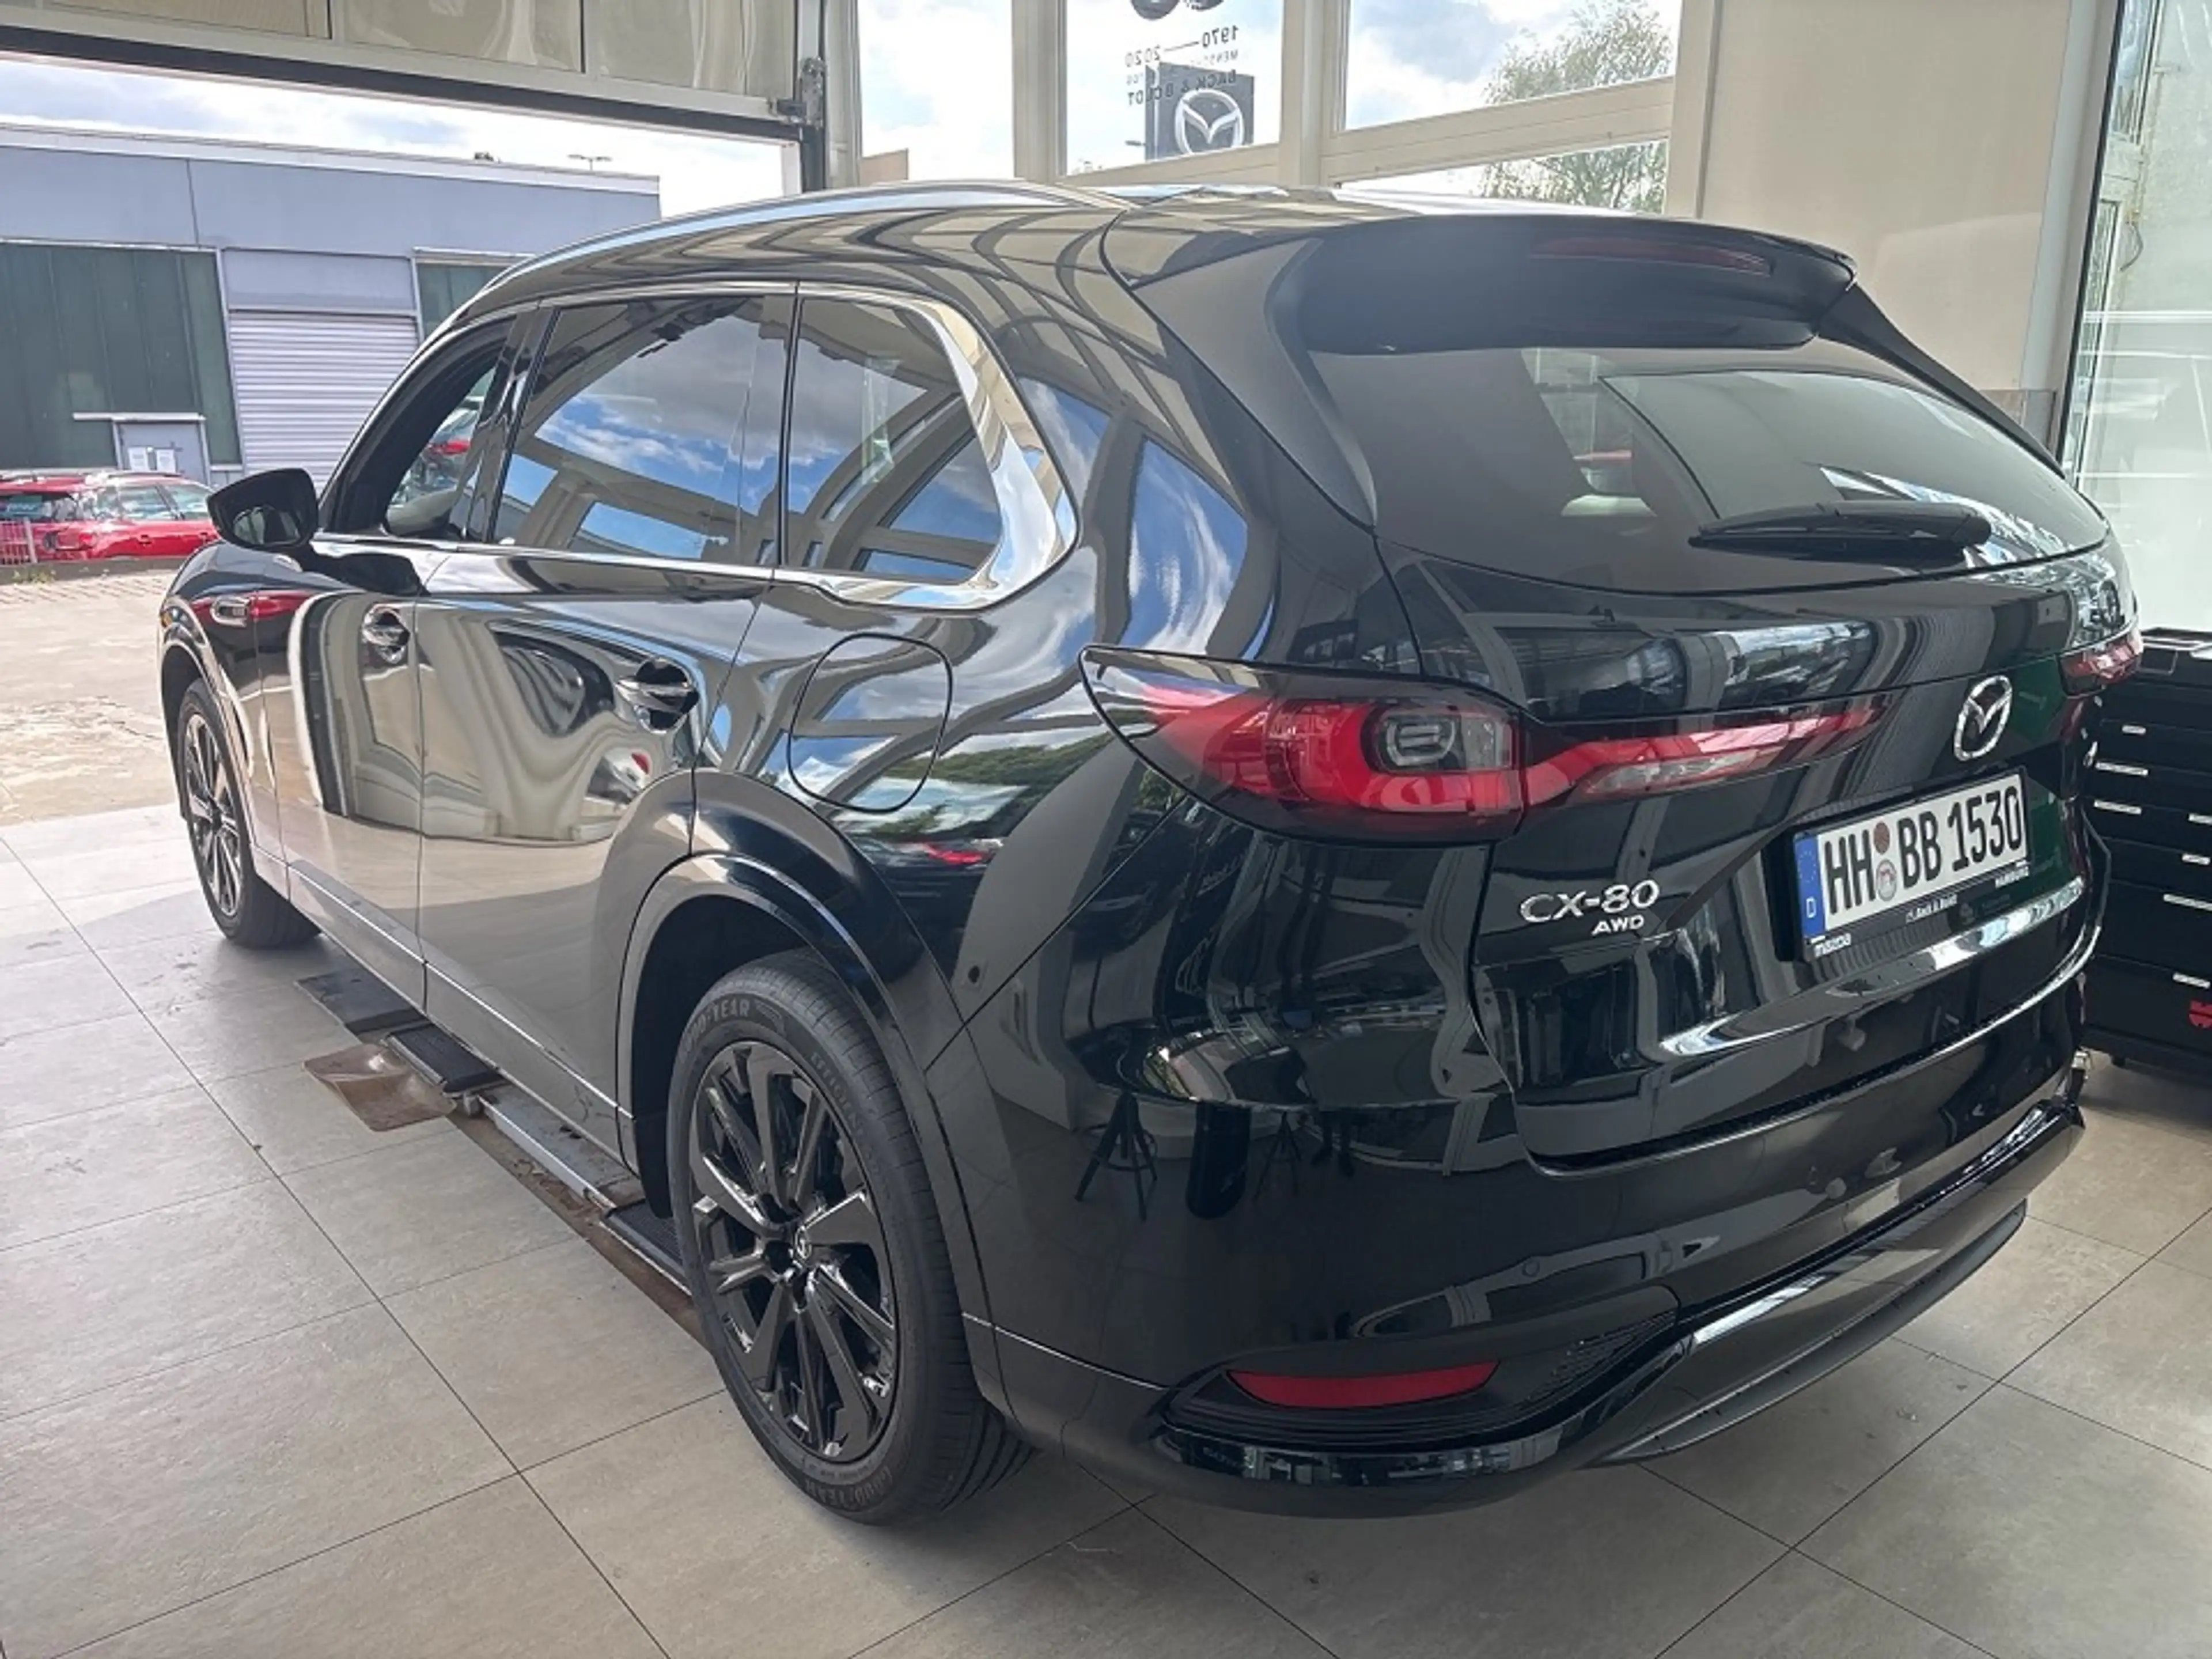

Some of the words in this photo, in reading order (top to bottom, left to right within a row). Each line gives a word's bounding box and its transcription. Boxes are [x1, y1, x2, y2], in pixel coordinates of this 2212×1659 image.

[1823, 828, 1876, 915] HH
[1896, 810, 1942, 889] BB
[1946, 785, 2023, 873] 1530
[1520, 879, 1661, 923] CX-80
[1590, 914, 1645, 937] AWD
